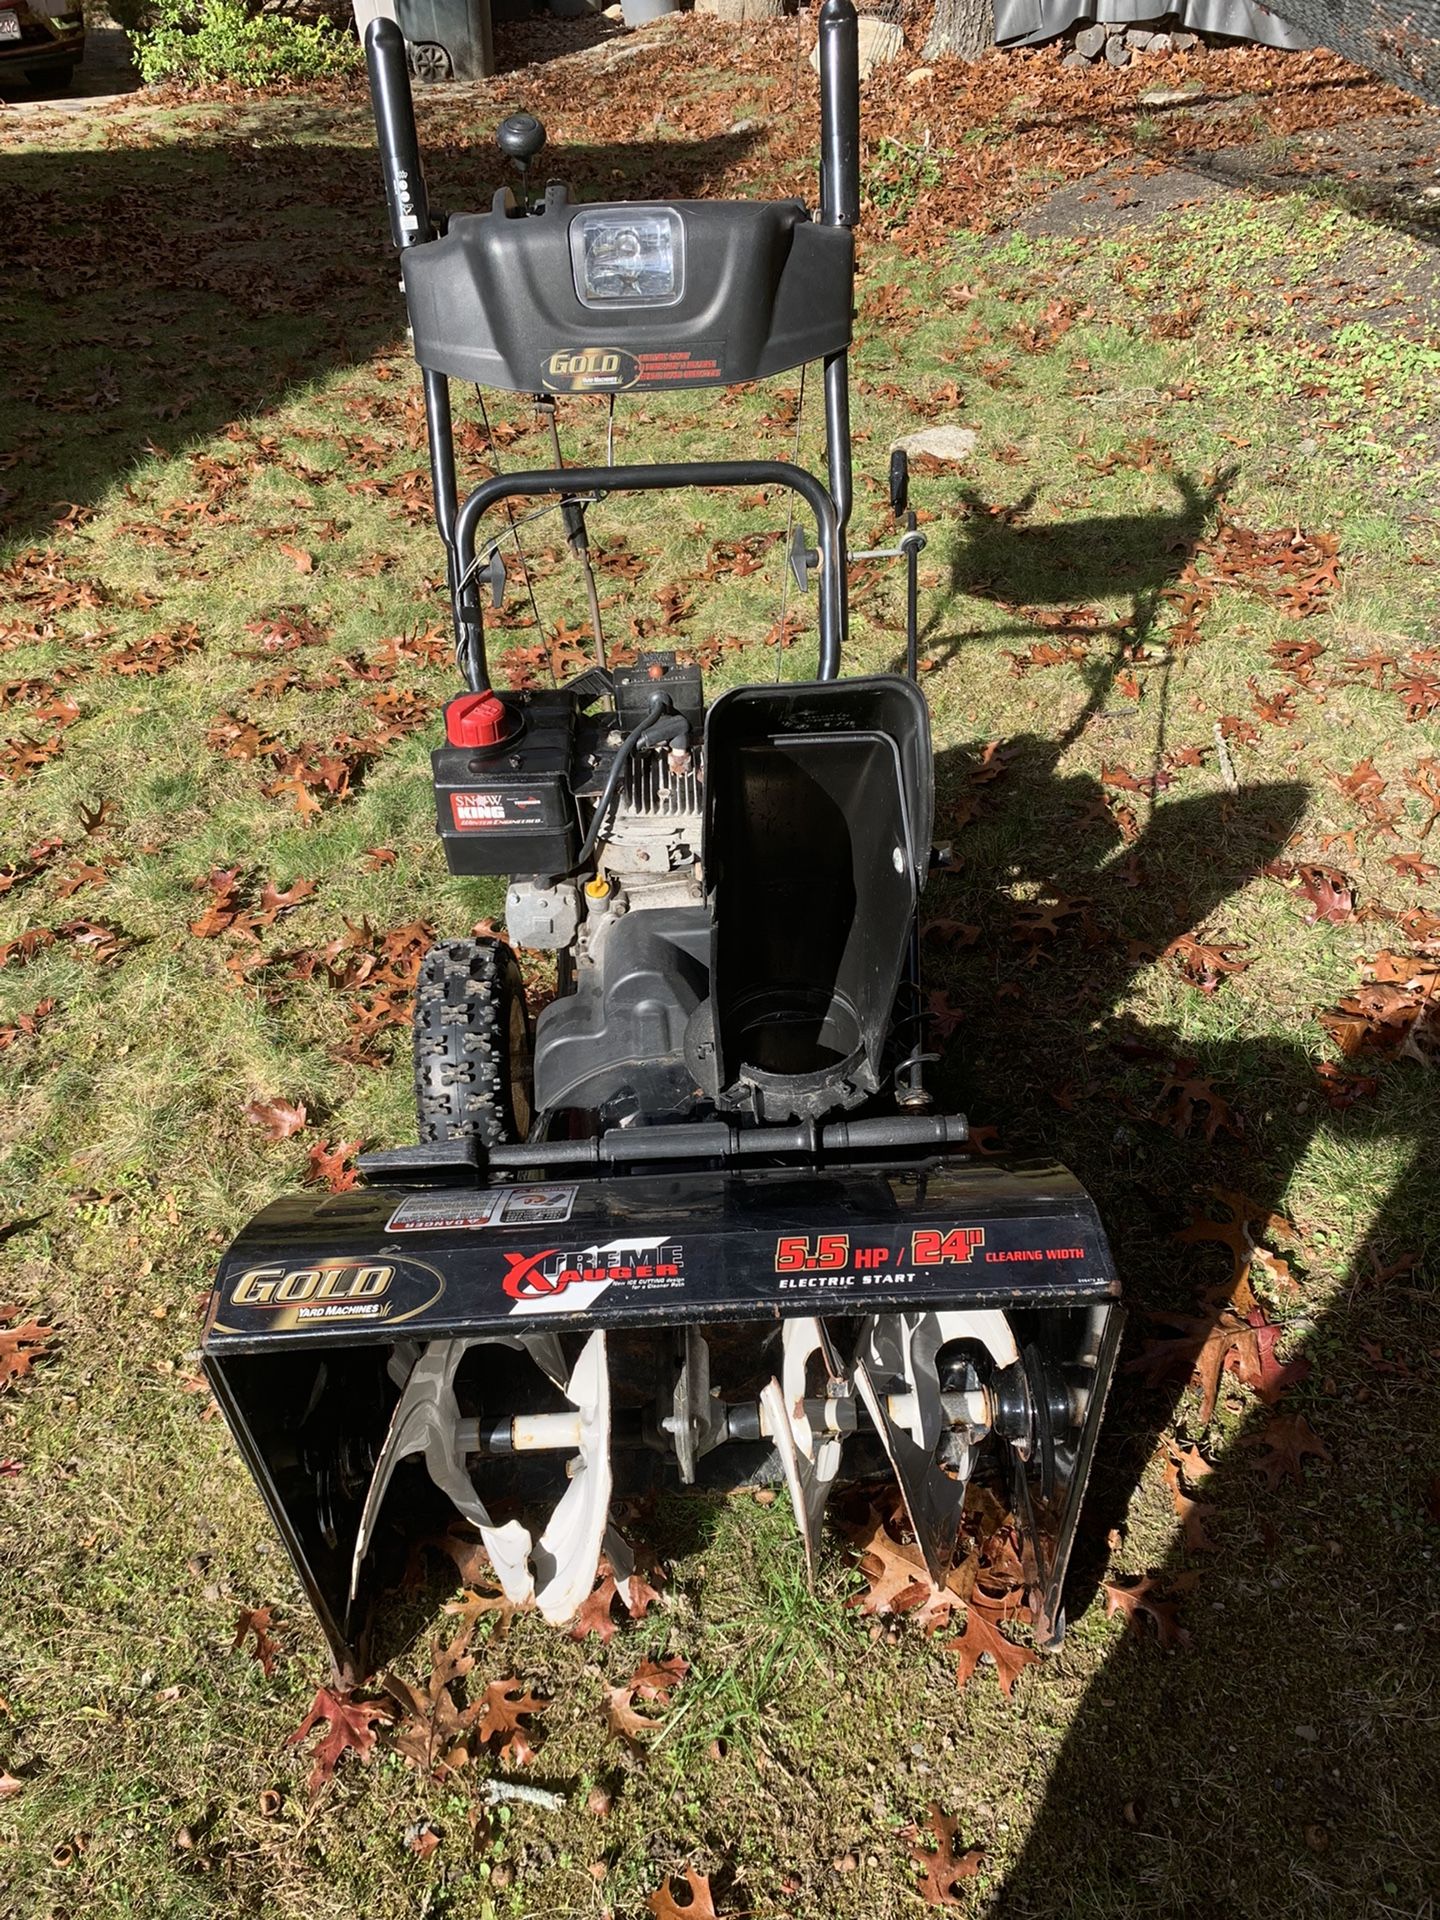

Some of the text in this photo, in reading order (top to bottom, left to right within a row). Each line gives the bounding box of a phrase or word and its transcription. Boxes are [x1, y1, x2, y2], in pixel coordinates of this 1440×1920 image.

[549, 354, 620, 375] GOLD
[457, 806, 505, 819] KING
[405, 1220, 464, 1229] DANGER
[774, 1227, 1085, 1272] 5.5 HP / 24" CLEARING WIDTH
[556, 1264, 679, 1284] AUGER
[779, 1273, 916, 1289] ELECTRIC START
[230, 1265, 396, 1307] GOLD
[299, 1304, 379, 1318] YARD MACHINES
